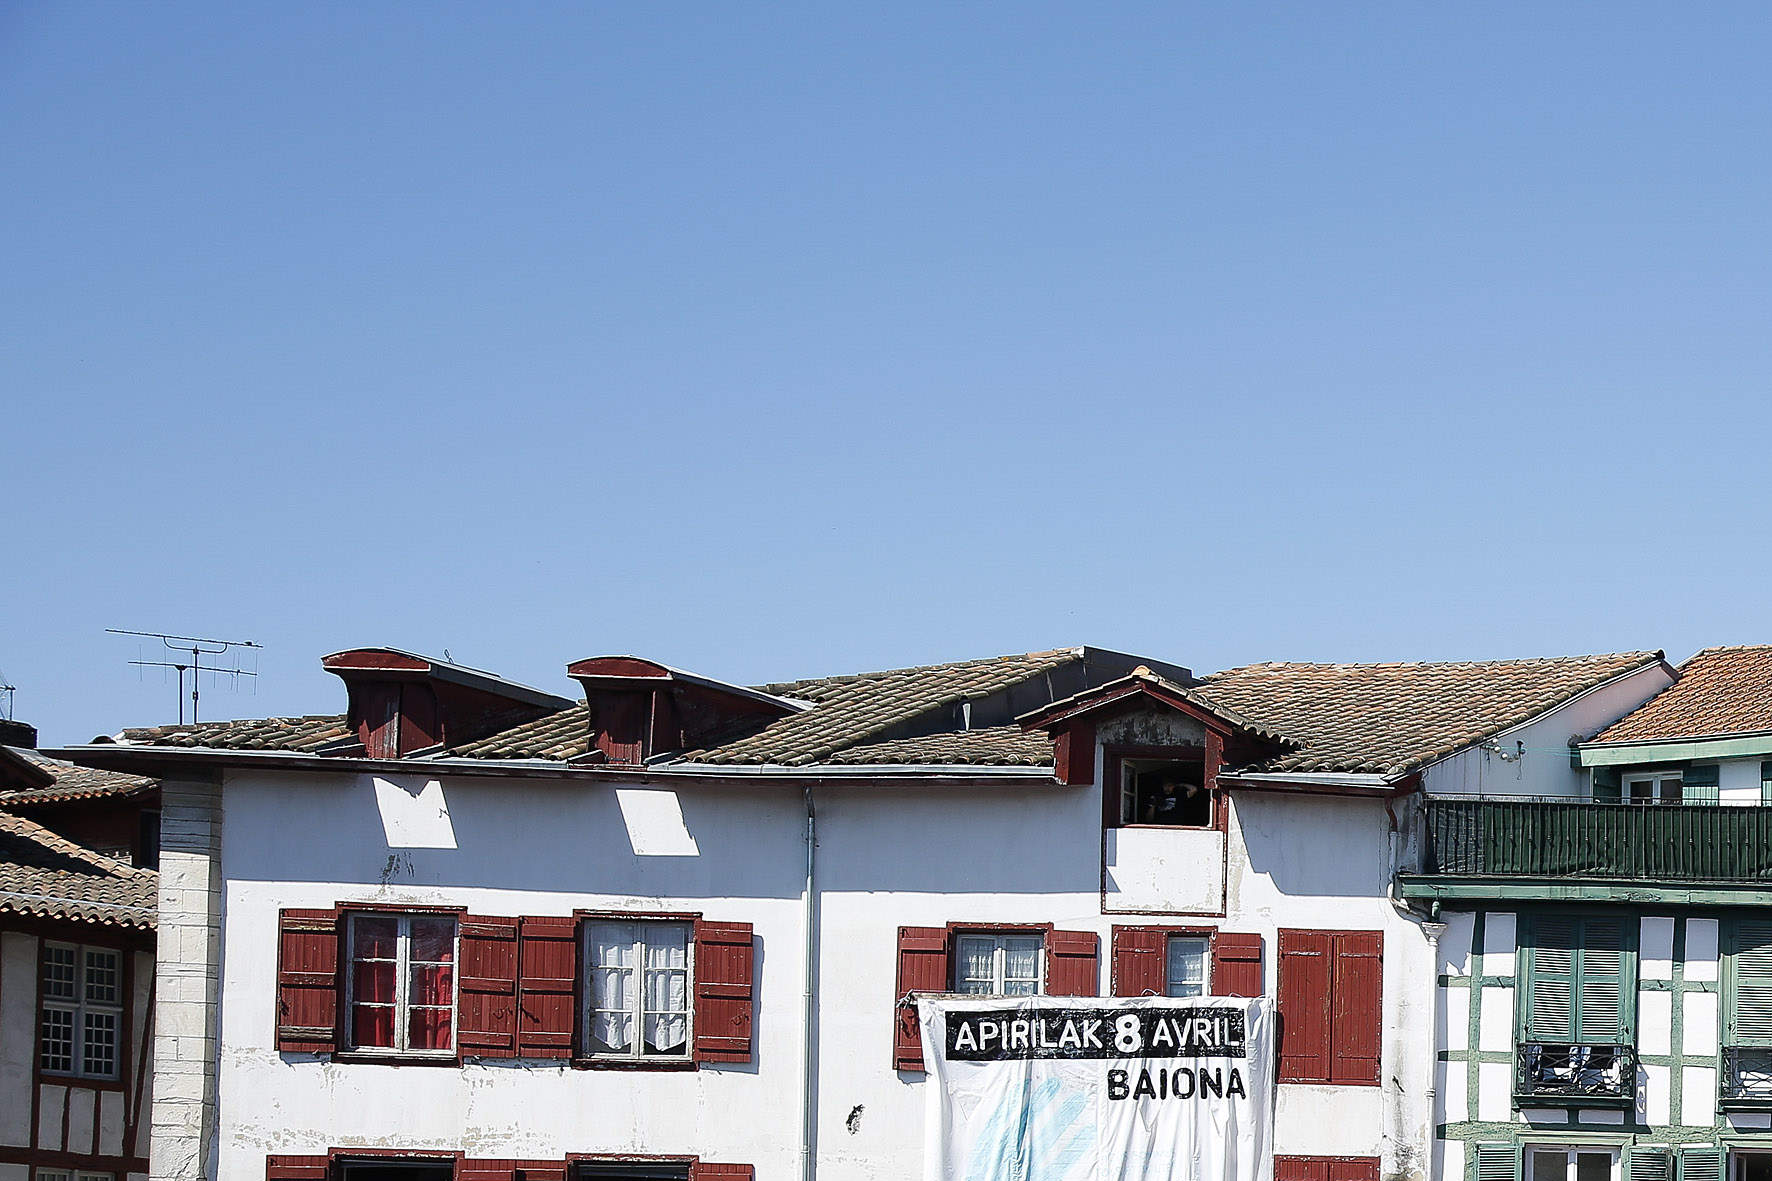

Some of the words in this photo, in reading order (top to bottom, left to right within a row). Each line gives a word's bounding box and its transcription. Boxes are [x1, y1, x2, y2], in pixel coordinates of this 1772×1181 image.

[955, 1018, 1103, 1052] APIRILAK
[1113, 1013, 1142, 1053] 8
[1152, 1015, 1241, 1049] AVRIL
[1106, 1066, 1247, 1101] BAIONA
